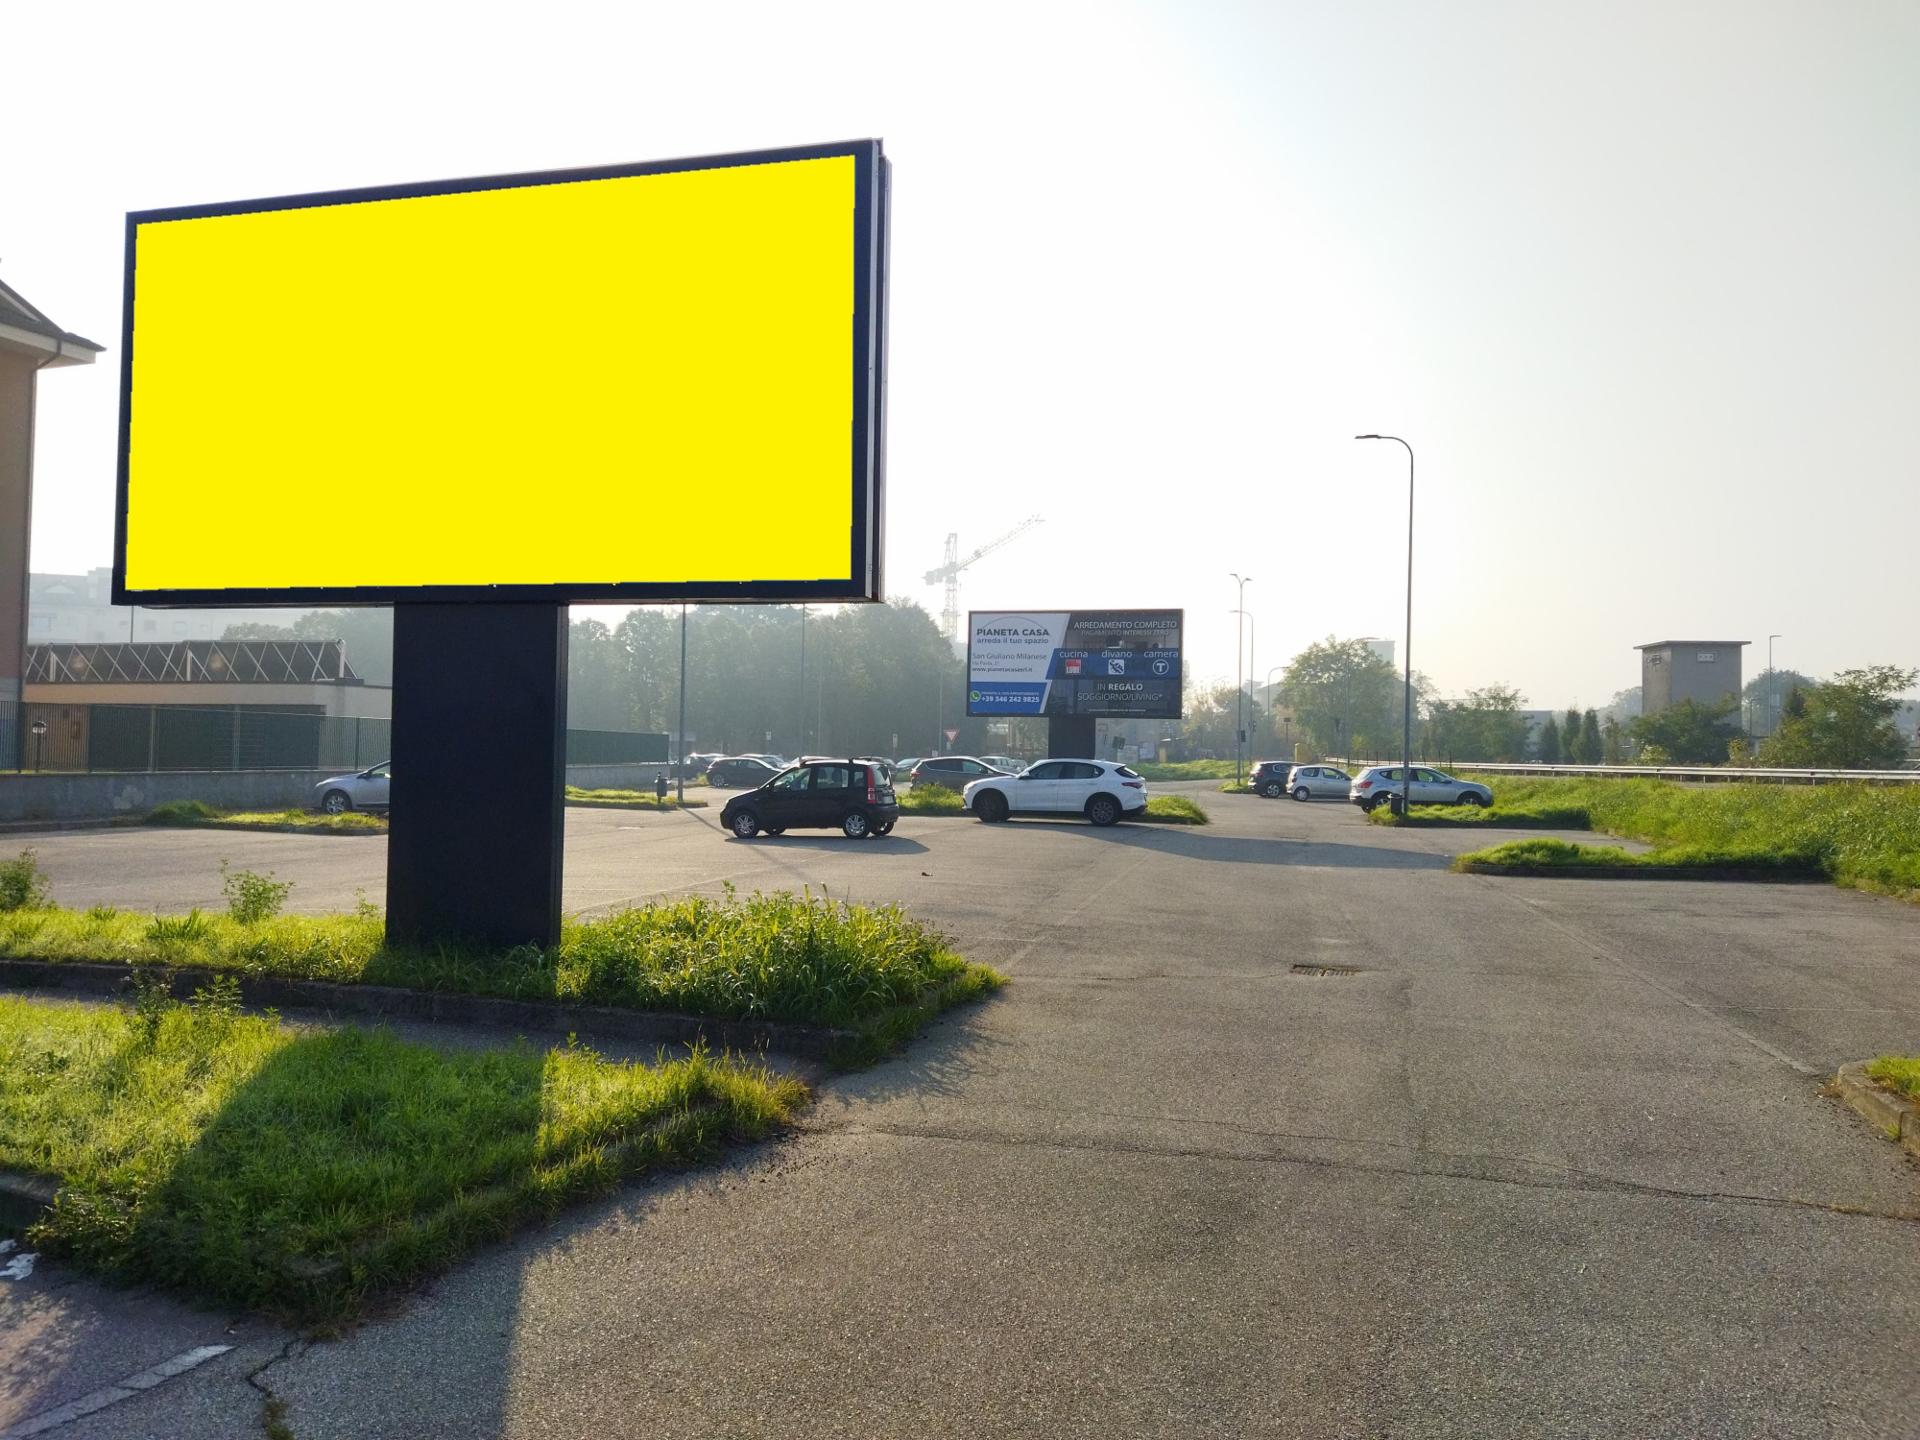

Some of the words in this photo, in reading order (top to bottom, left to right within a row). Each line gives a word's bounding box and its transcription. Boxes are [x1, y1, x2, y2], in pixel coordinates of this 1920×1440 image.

[1074, 621, 1133, 629] ARREDAMENTO
[1134, 620, 1177, 629] COMPLETO
[977, 628, 1020, 636] PIANETA
[1022, 628, 1050, 636] CASA
[1024, 637, 1049, 645] spazio
[1059, 650, 1089, 658] cucina
[1101, 649, 1133, 658] divano
[1097, 683, 1106, 691] IN
[1108, 683, 1144, 691] REGALO
